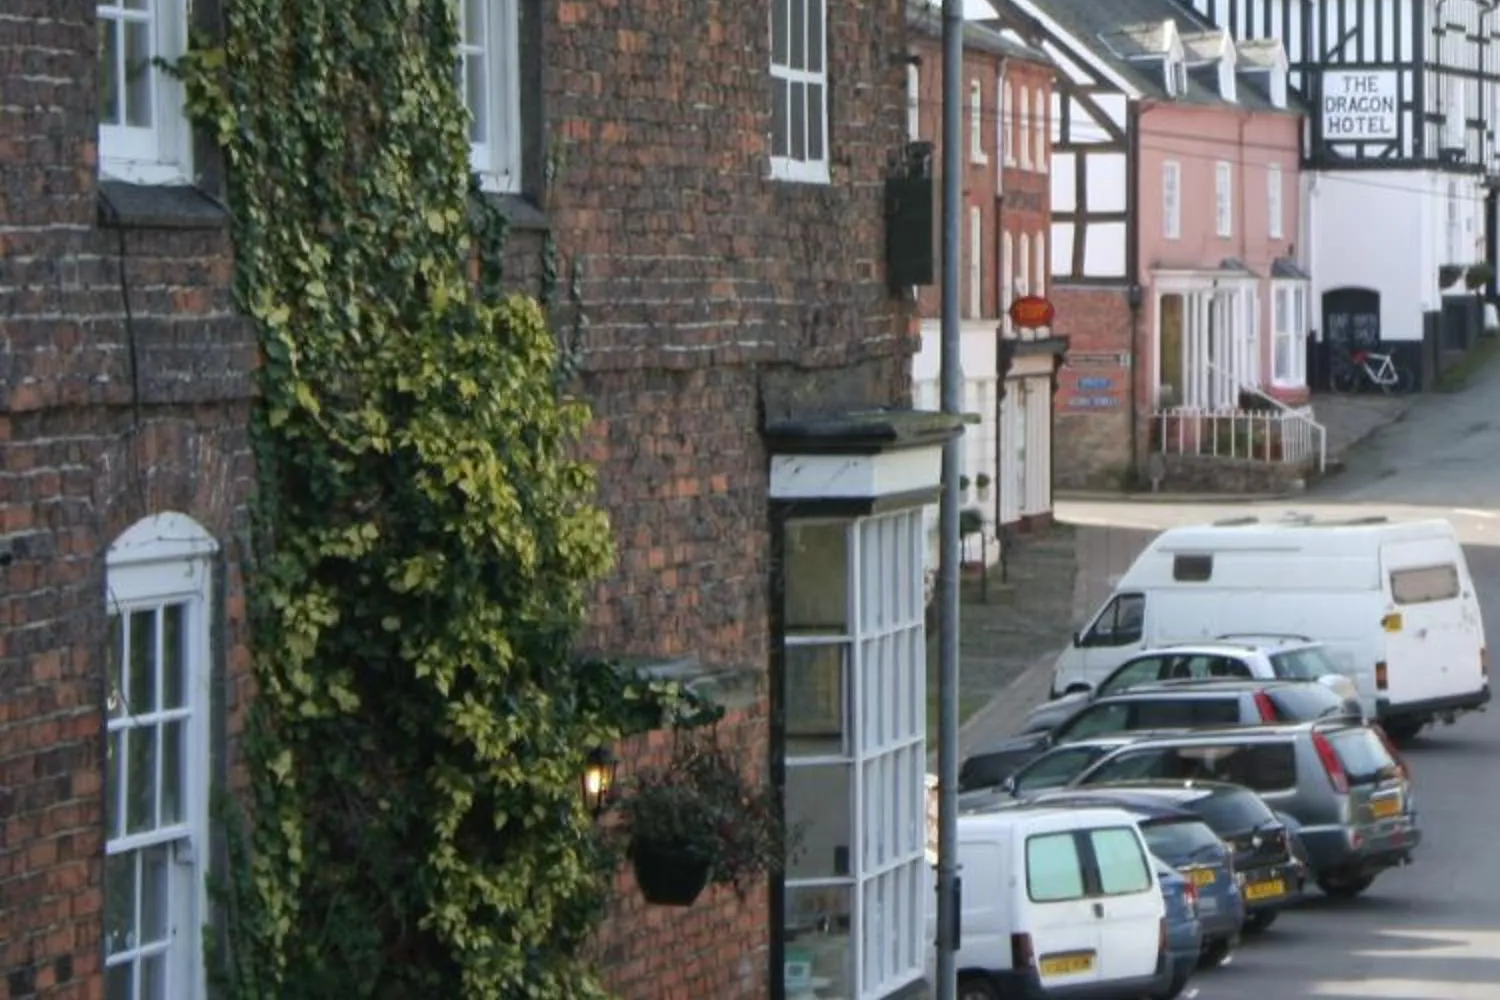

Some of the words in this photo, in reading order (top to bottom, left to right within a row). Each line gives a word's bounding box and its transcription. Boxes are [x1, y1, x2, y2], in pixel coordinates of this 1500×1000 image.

[1343, 75, 1379, 92] THE
[1325, 95, 1393, 113] DRAGON
[1327, 115, 1391, 133] HOTEL
